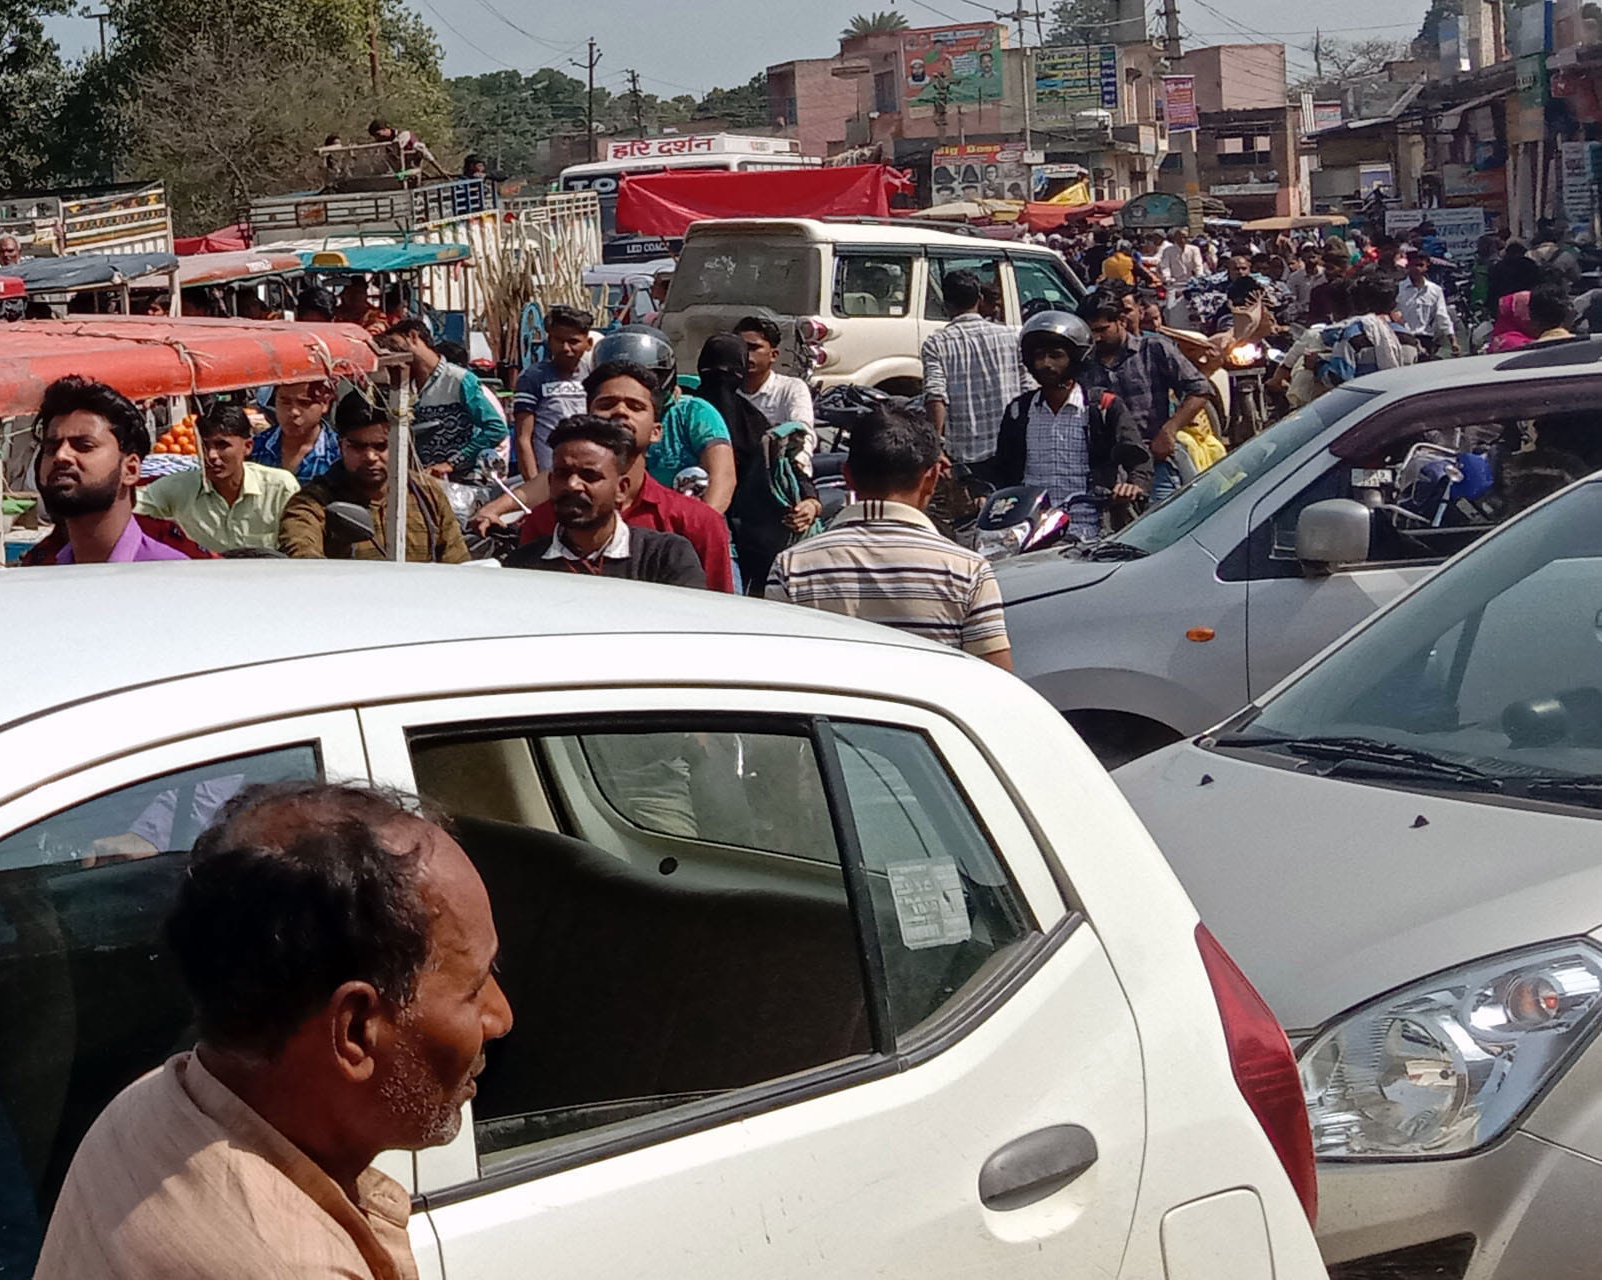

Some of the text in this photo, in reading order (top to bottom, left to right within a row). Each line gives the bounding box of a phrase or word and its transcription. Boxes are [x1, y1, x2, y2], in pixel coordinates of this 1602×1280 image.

[613, 136, 716, 159] हरि दर्शन
[626, 244, 643, 254] LED
